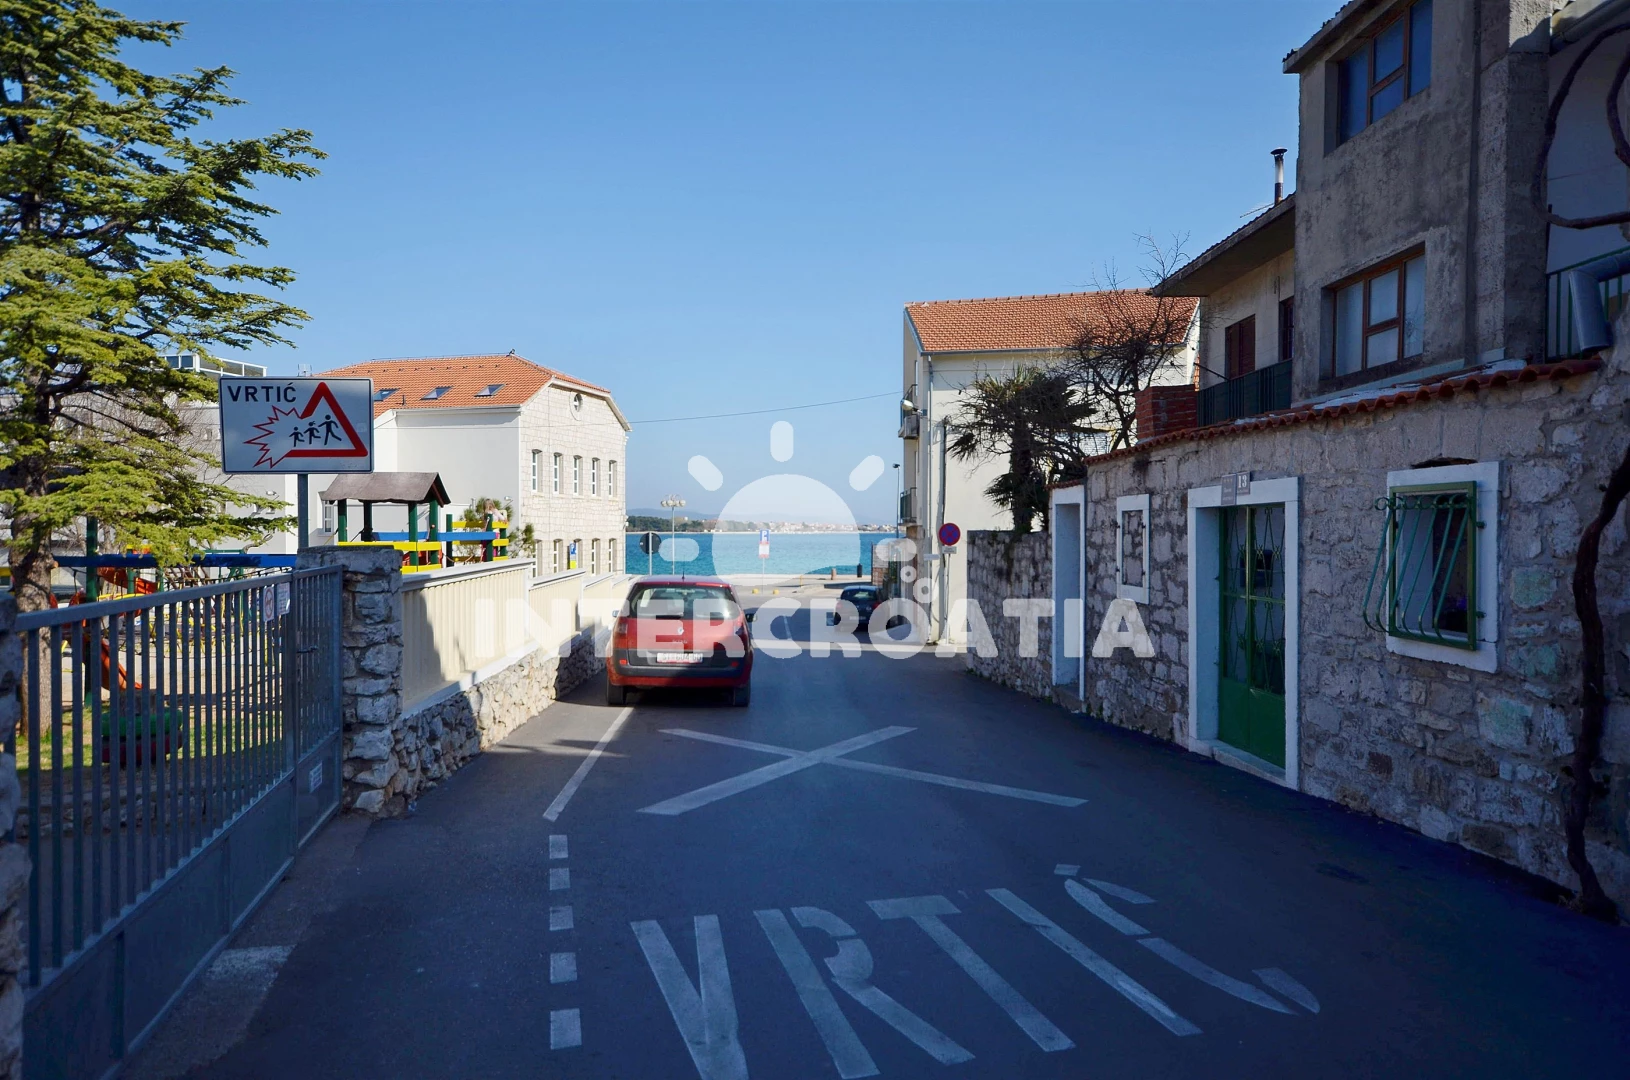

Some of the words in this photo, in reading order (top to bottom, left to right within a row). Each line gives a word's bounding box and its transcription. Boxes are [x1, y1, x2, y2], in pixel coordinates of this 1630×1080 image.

[227, 381, 297, 403] VRTIĆ
[1238, 475, 1247, 488] 13
[630, 863, 1321, 1080] VRTIĆ
